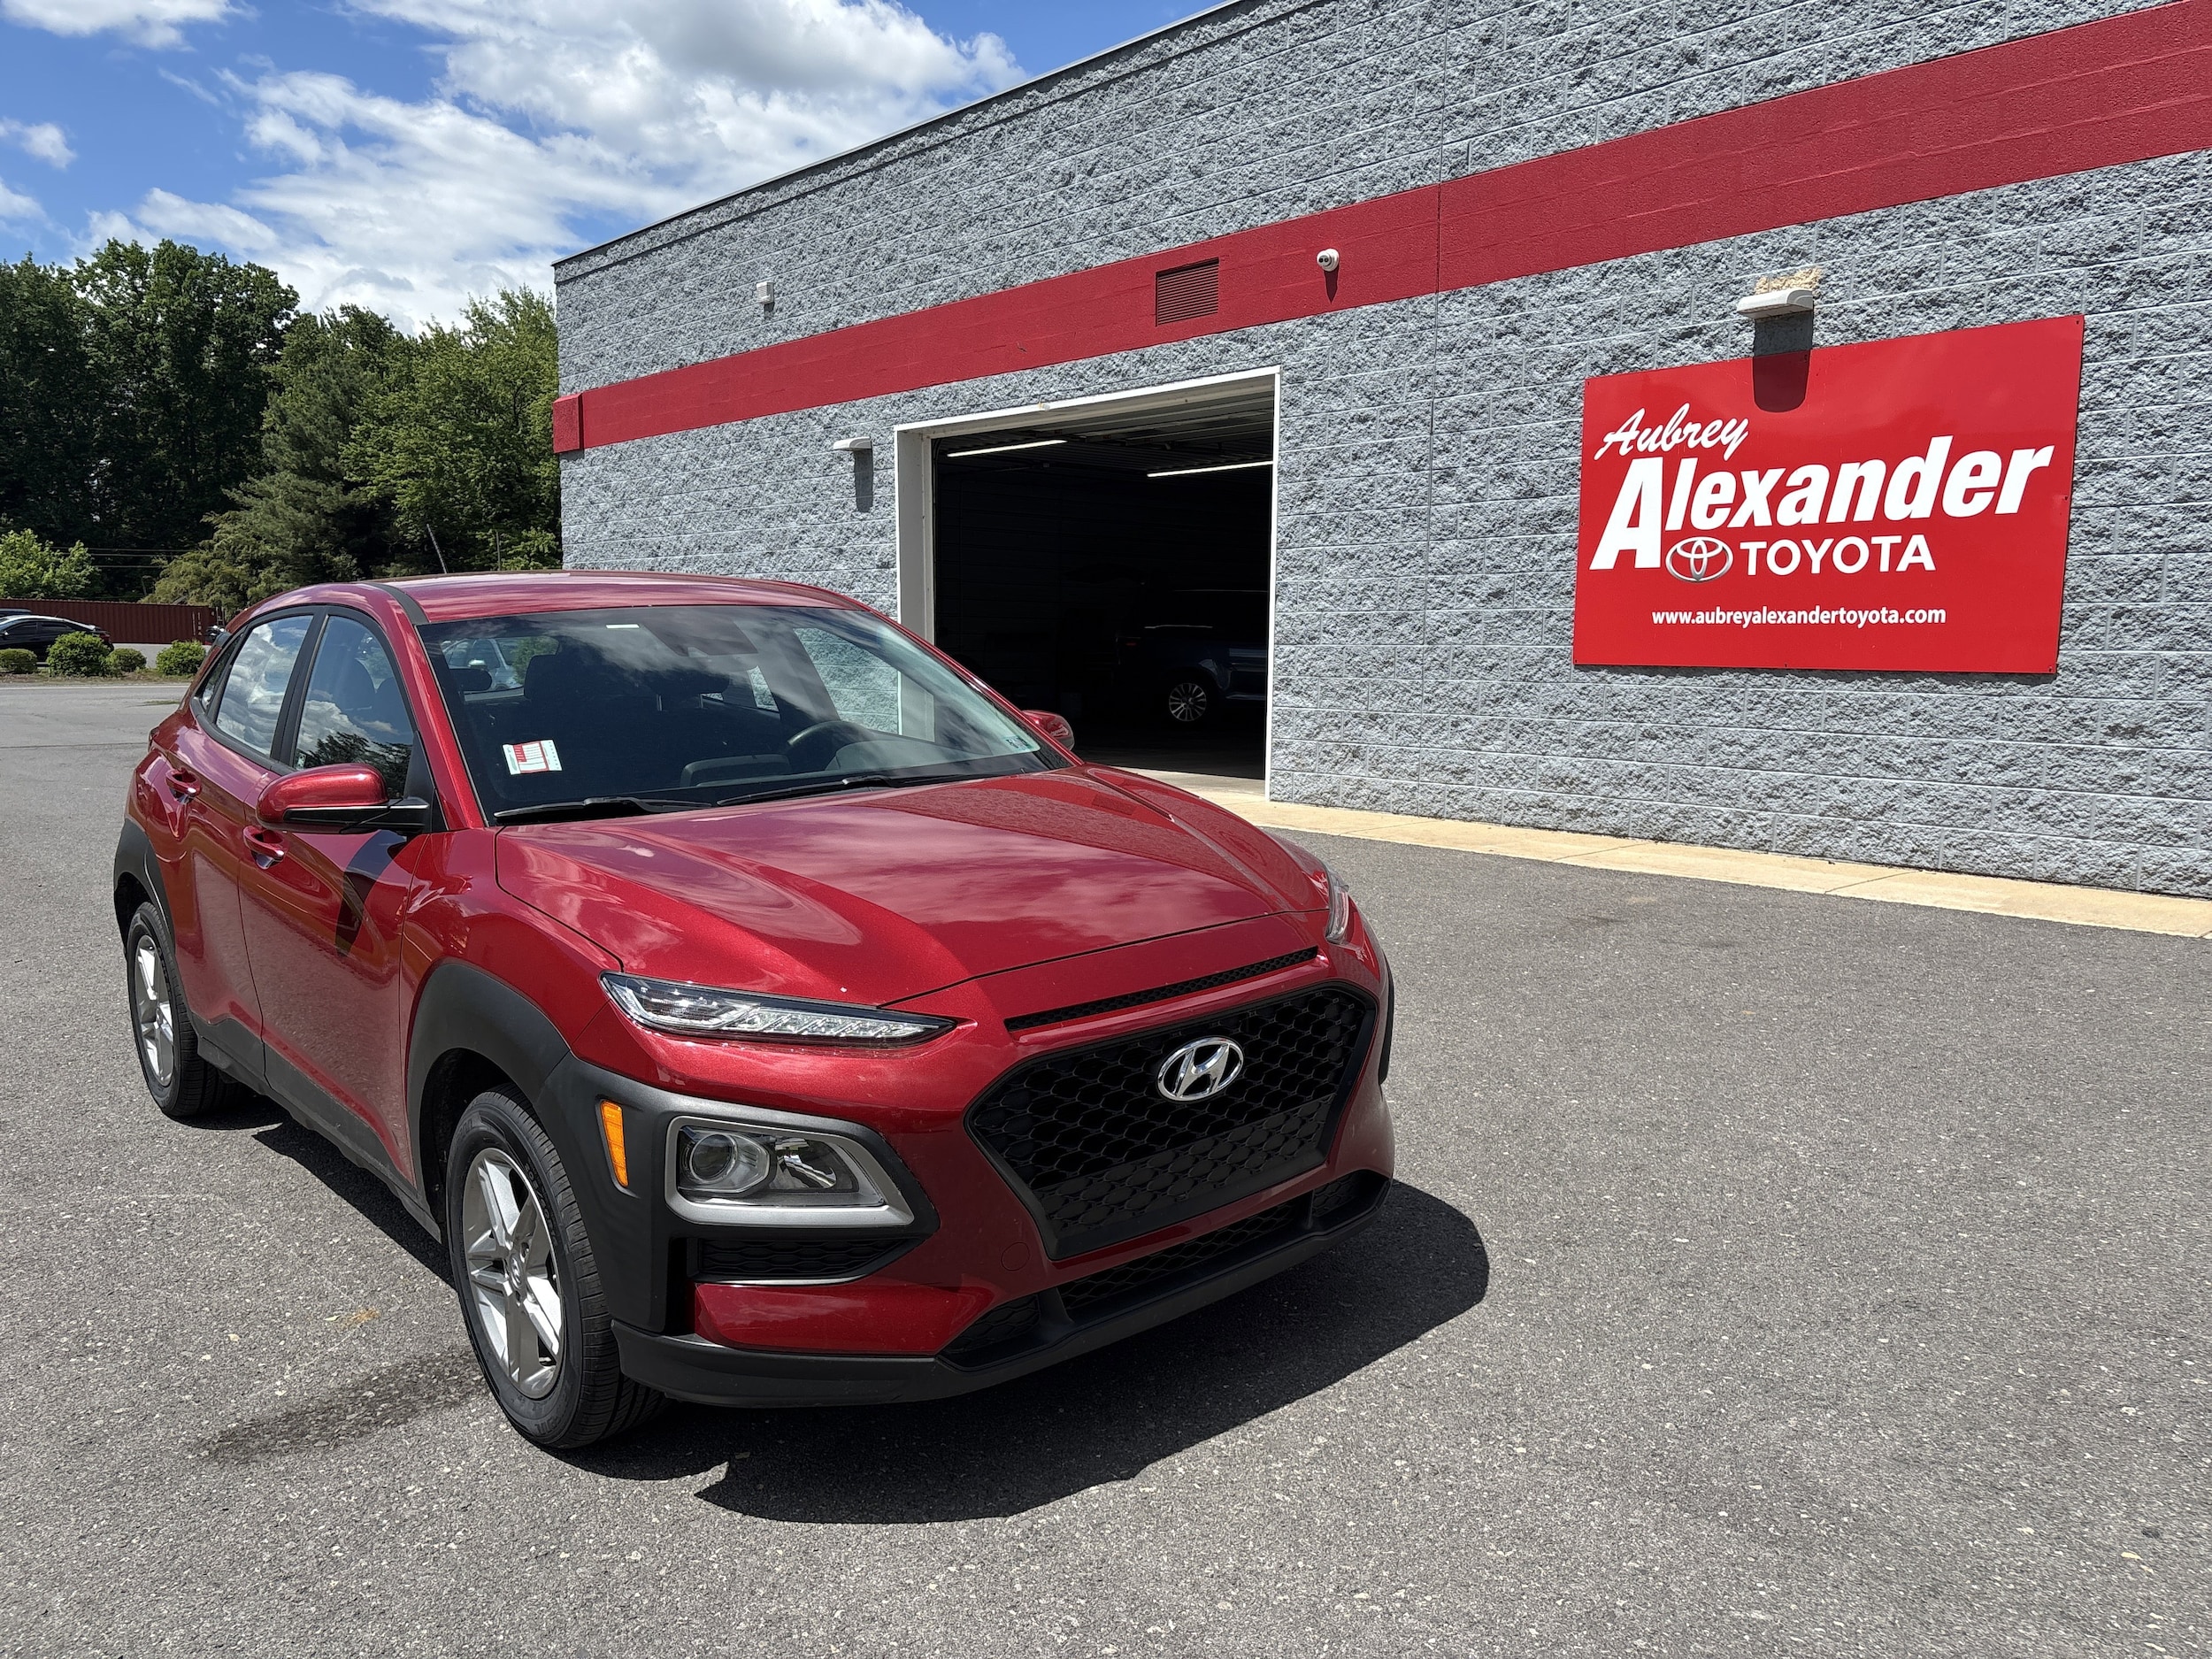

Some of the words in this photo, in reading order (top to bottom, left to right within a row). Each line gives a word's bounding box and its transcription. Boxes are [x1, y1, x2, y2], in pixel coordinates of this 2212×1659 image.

[1594, 403, 1749, 461] Aubrey
[1589, 436, 2055, 571] Alexander
[1740, 534, 1936, 576] TOYOTA
[1652, 605, 1947, 630] www.aubreyalexandertoyota.com
